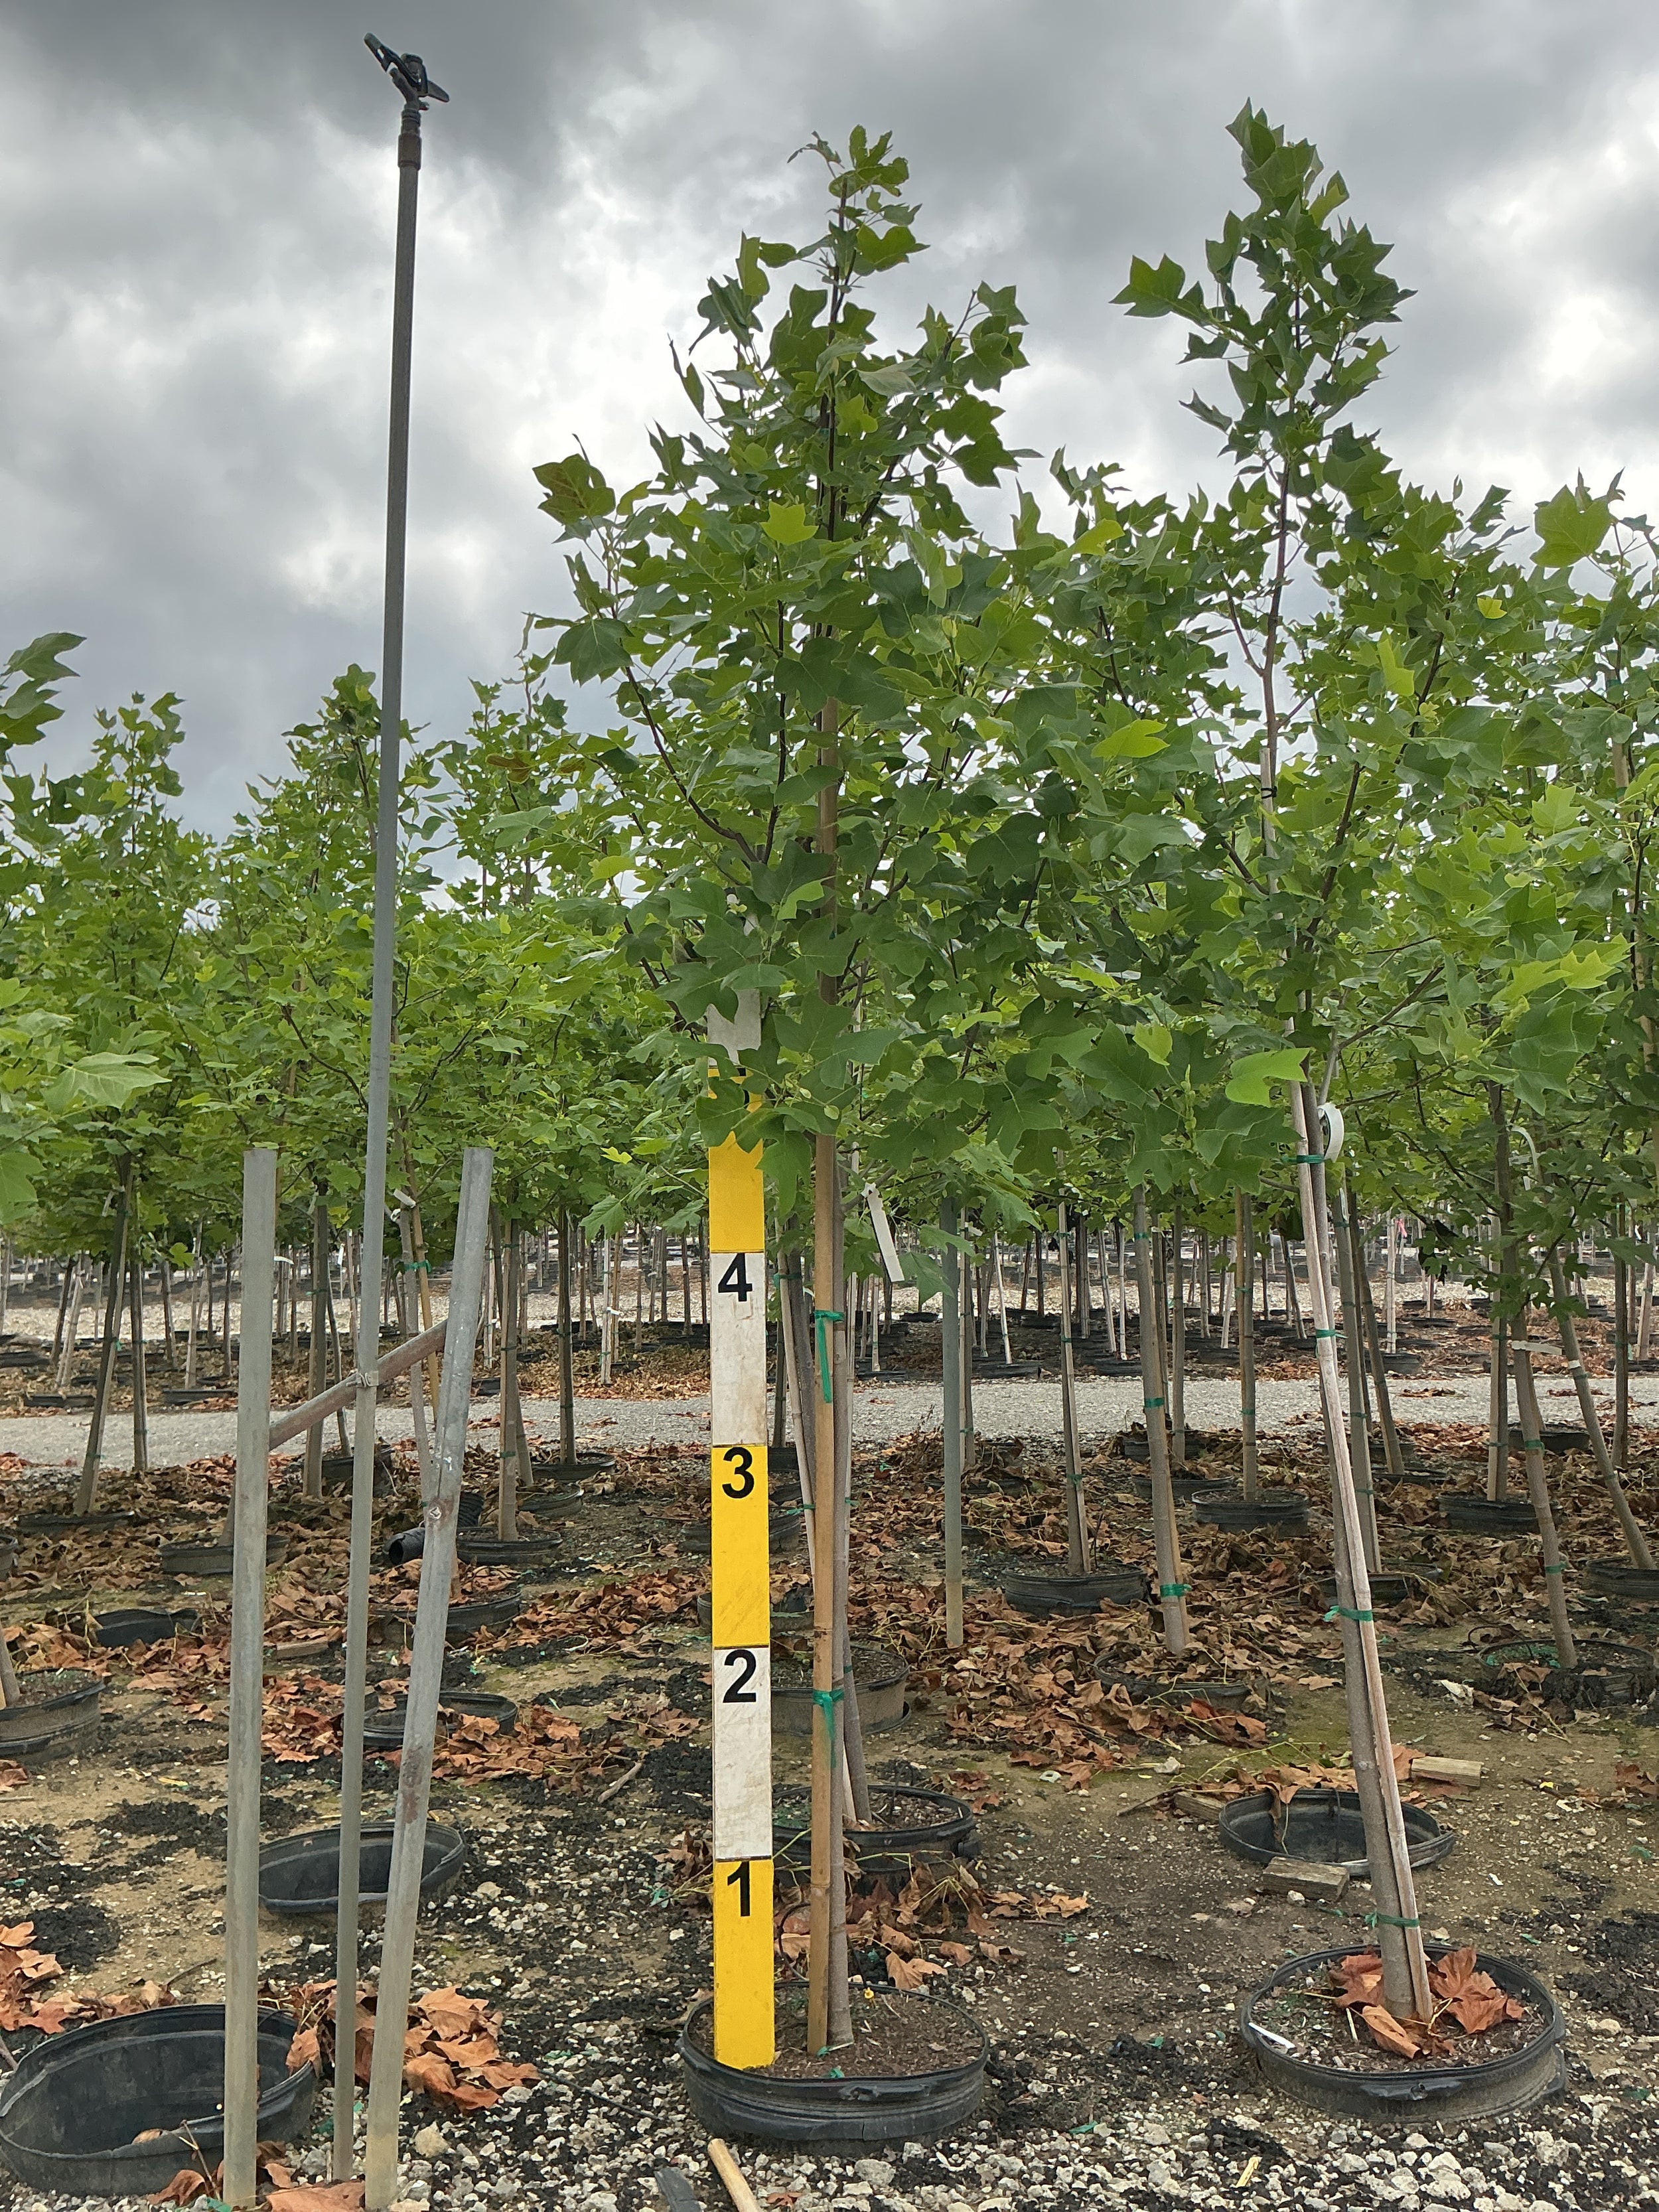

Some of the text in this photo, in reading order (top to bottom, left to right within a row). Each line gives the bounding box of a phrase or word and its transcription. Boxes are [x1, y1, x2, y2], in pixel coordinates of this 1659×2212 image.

[718, 1252, 753, 1301] 4
[722, 1447, 755, 1499] 3
[723, 1649, 757, 1703] 2
[727, 1862, 751, 1917] 1
